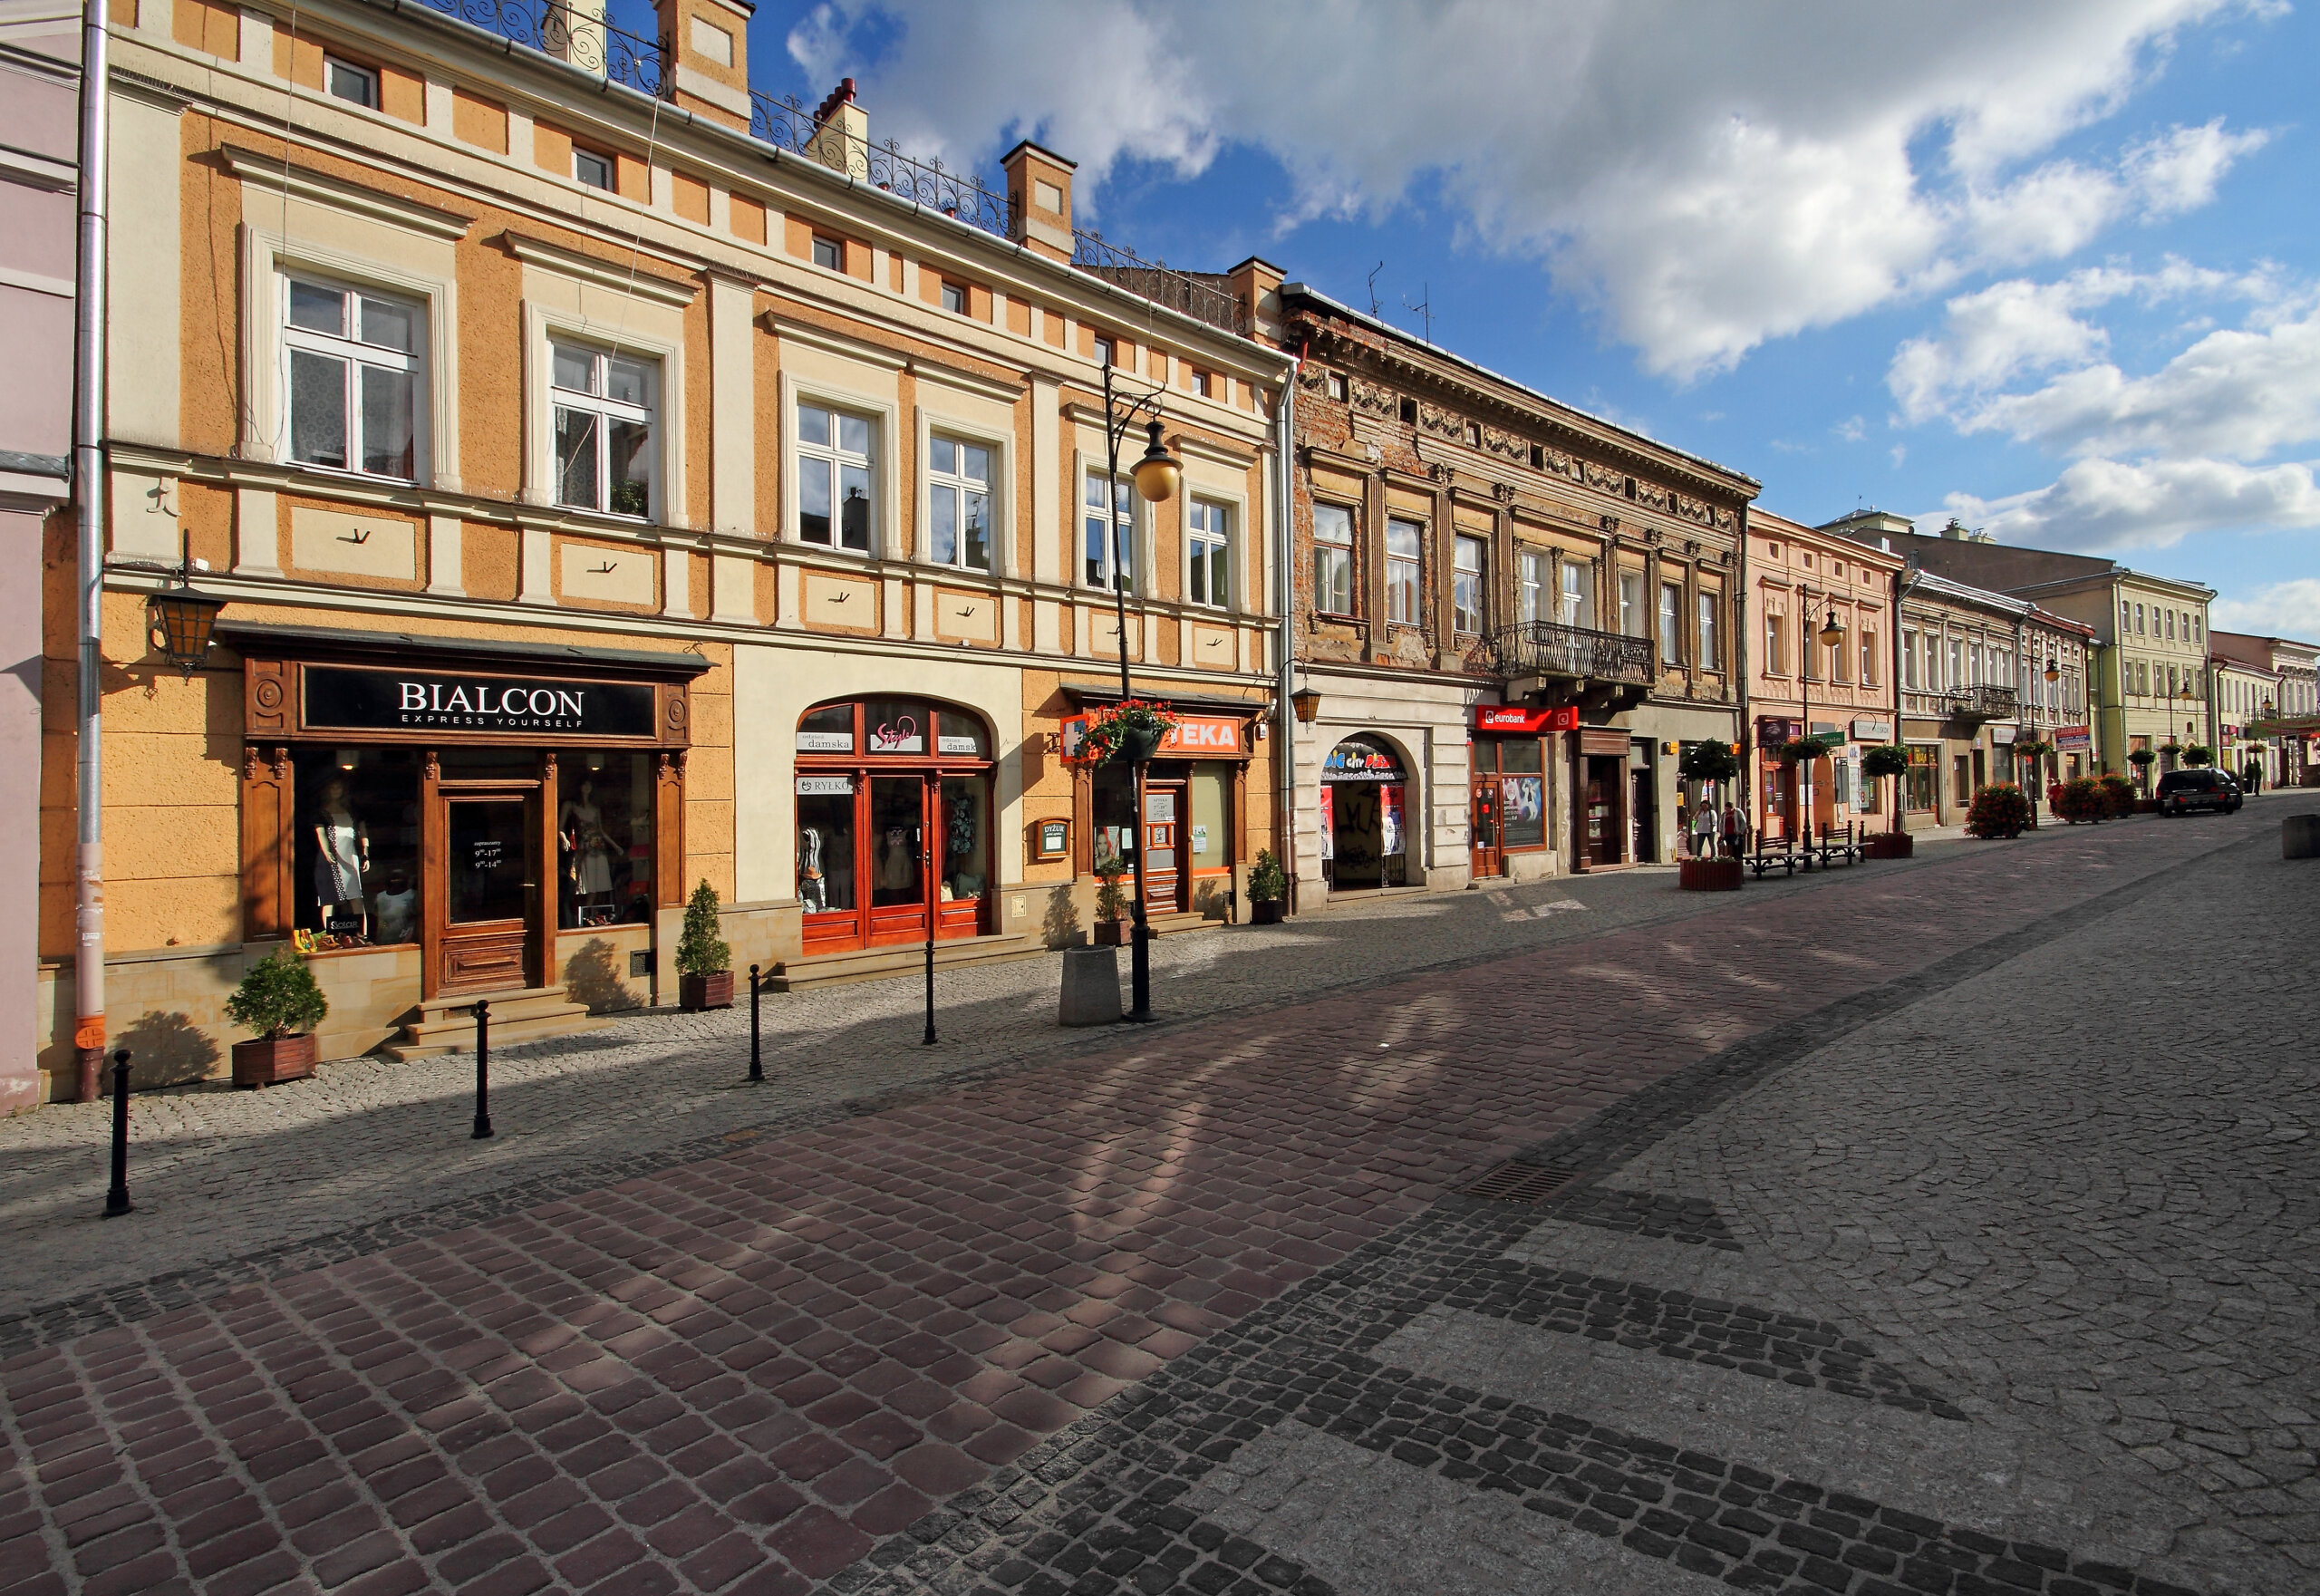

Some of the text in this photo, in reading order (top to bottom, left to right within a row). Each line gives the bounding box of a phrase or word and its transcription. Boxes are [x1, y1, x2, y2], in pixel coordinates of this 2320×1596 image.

[399, 682, 585, 717] BIALCON
[401, 714, 583, 728] EXPRESS YOURSELF
[1494, 713, 1524, 724] eurobank
[876, 715, 916, 750] Style
[1168, 722, 1235, 746] TEKA
[808, 740, 849, 749] damska
[815, 781, 849, 790] RYŁKO
[1044, 824, 1065, 833] DYŻUR
